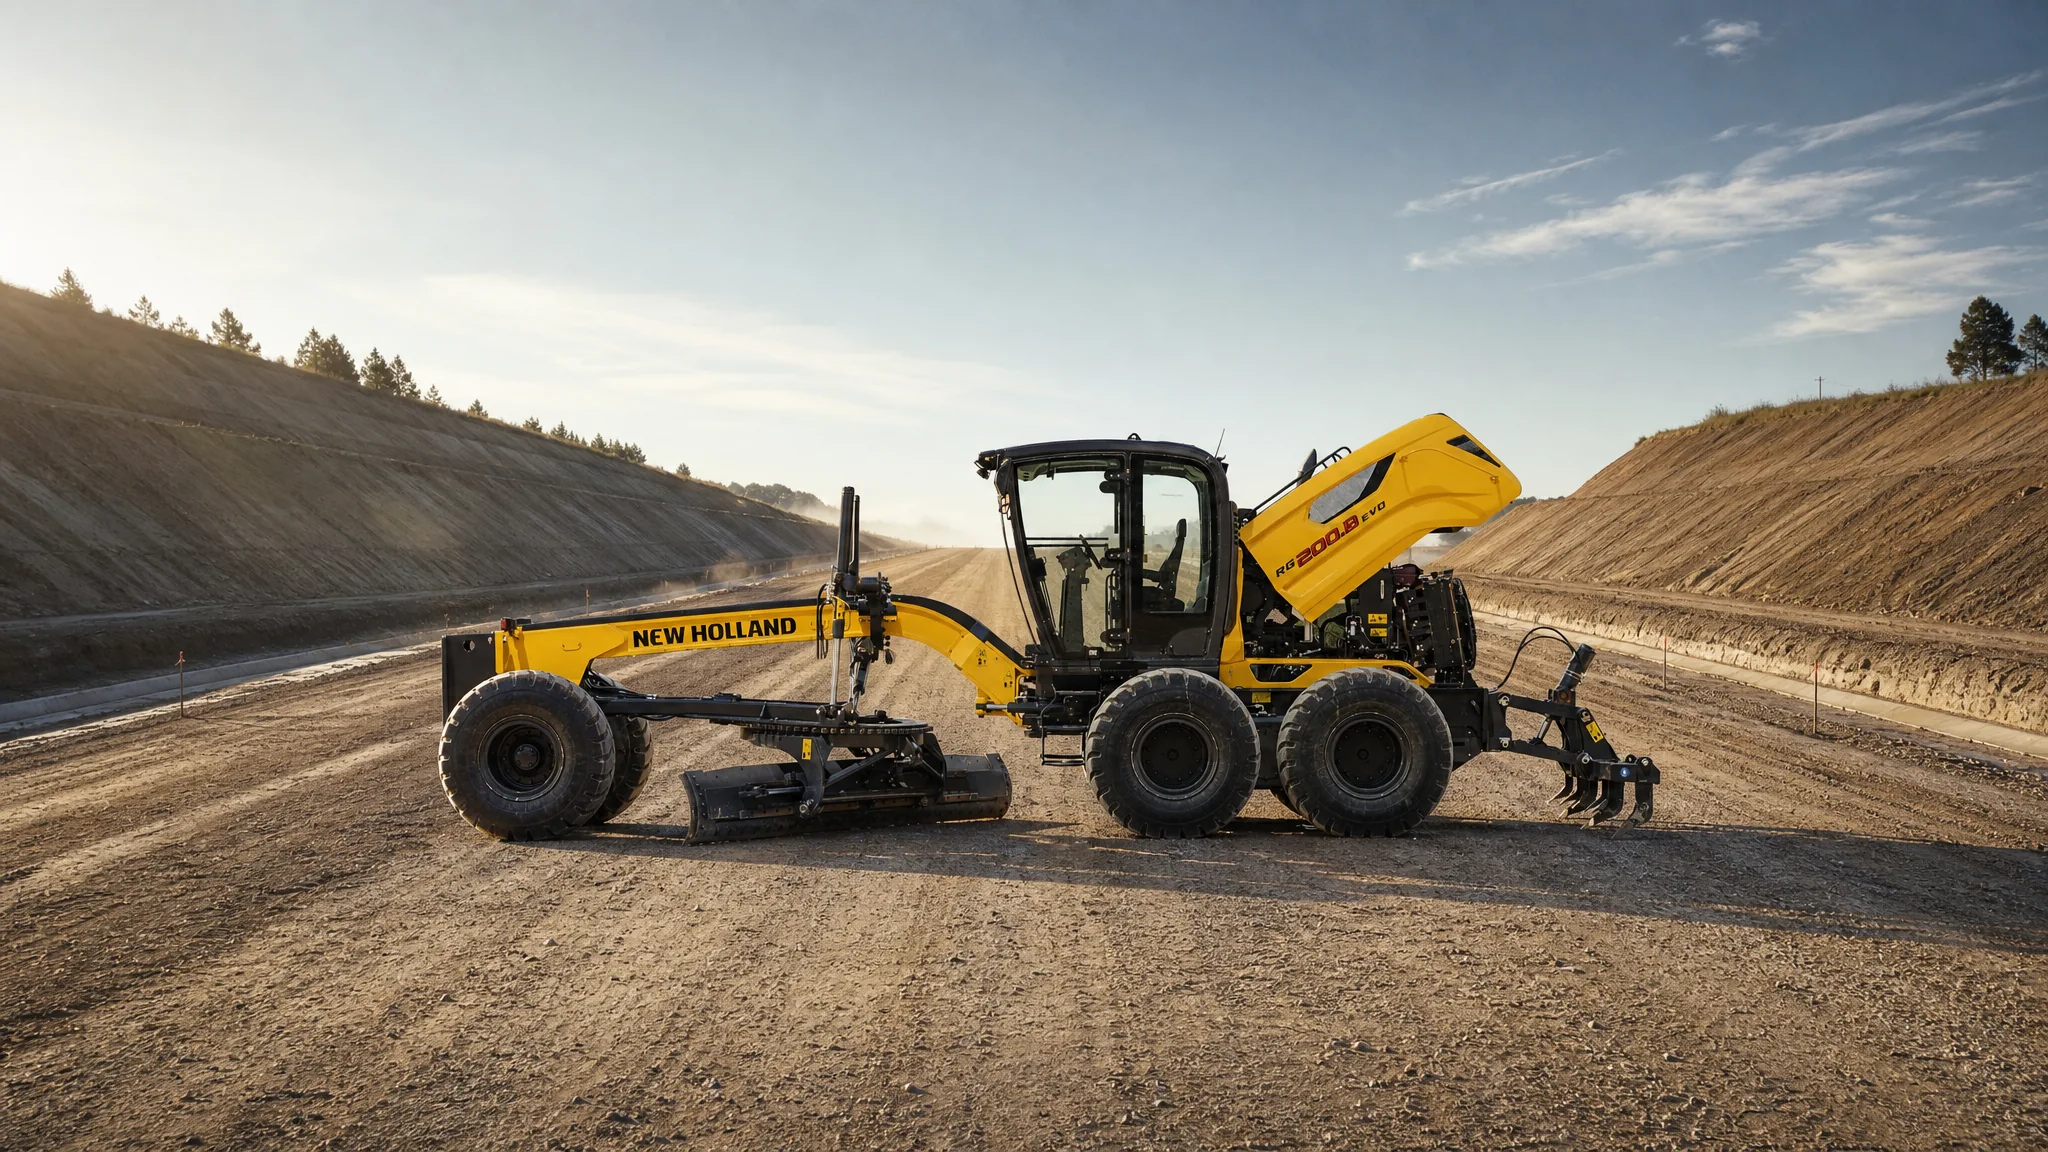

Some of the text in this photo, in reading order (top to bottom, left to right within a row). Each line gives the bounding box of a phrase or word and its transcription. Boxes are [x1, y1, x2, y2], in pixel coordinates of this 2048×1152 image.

[1361, 500, 1386, 523] EVO
[633, 617, 797, 648] NEW HOLLAND
